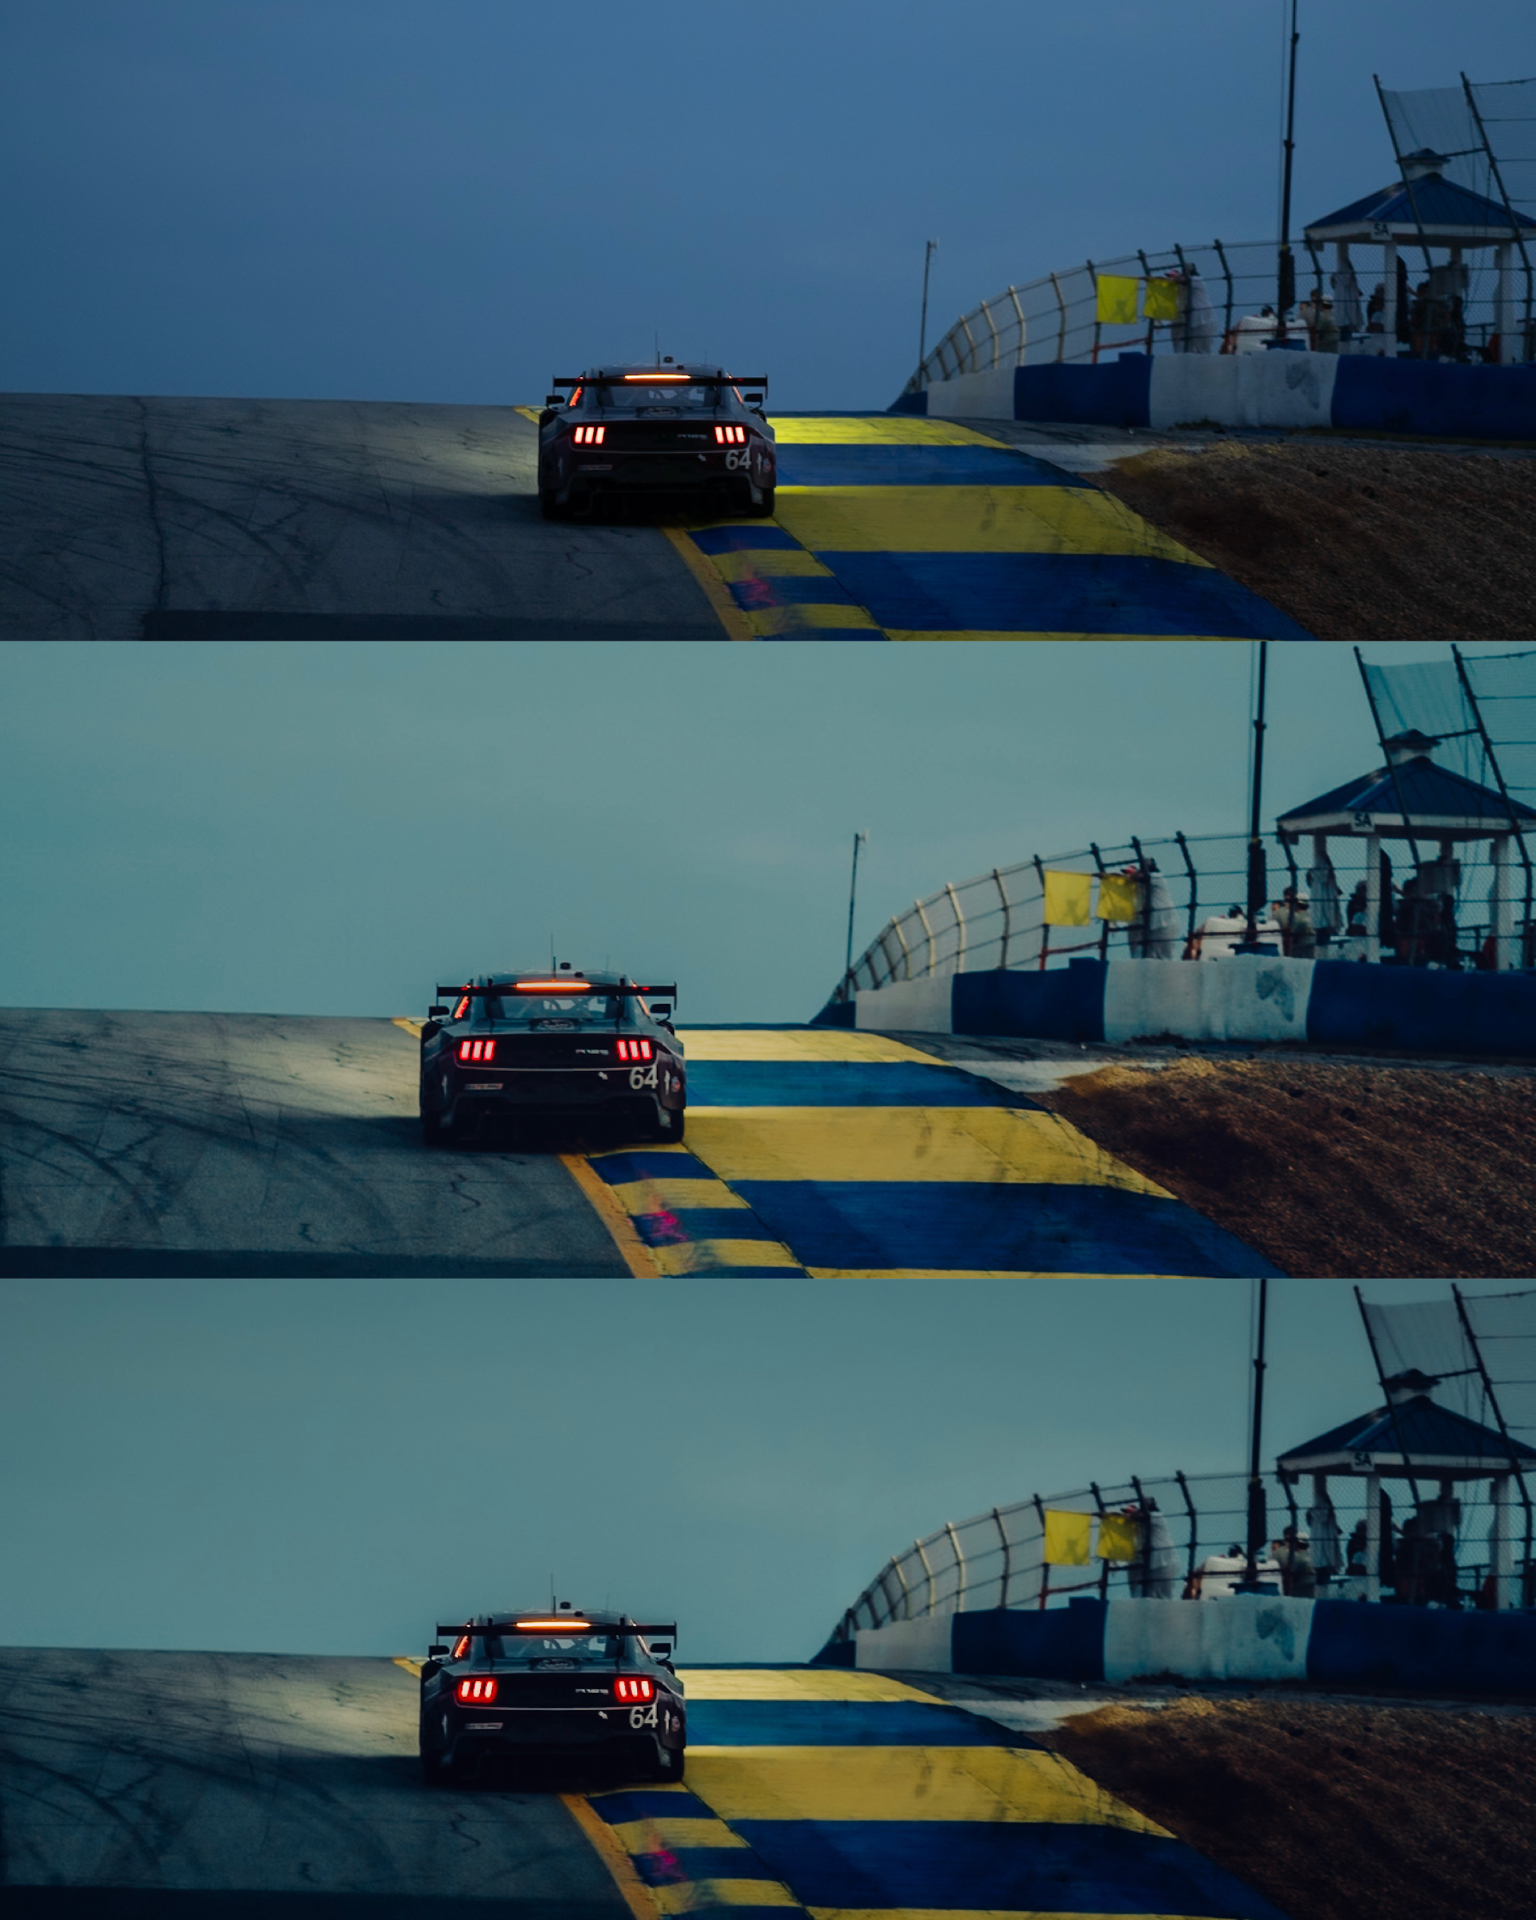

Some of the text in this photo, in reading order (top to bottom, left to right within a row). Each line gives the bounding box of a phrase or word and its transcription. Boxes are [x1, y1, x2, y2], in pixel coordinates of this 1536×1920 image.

[725, 449, 751, 470] 64
[629, 1064, 659, 1090] 64
[629, 1703, 659, 1729] 64
